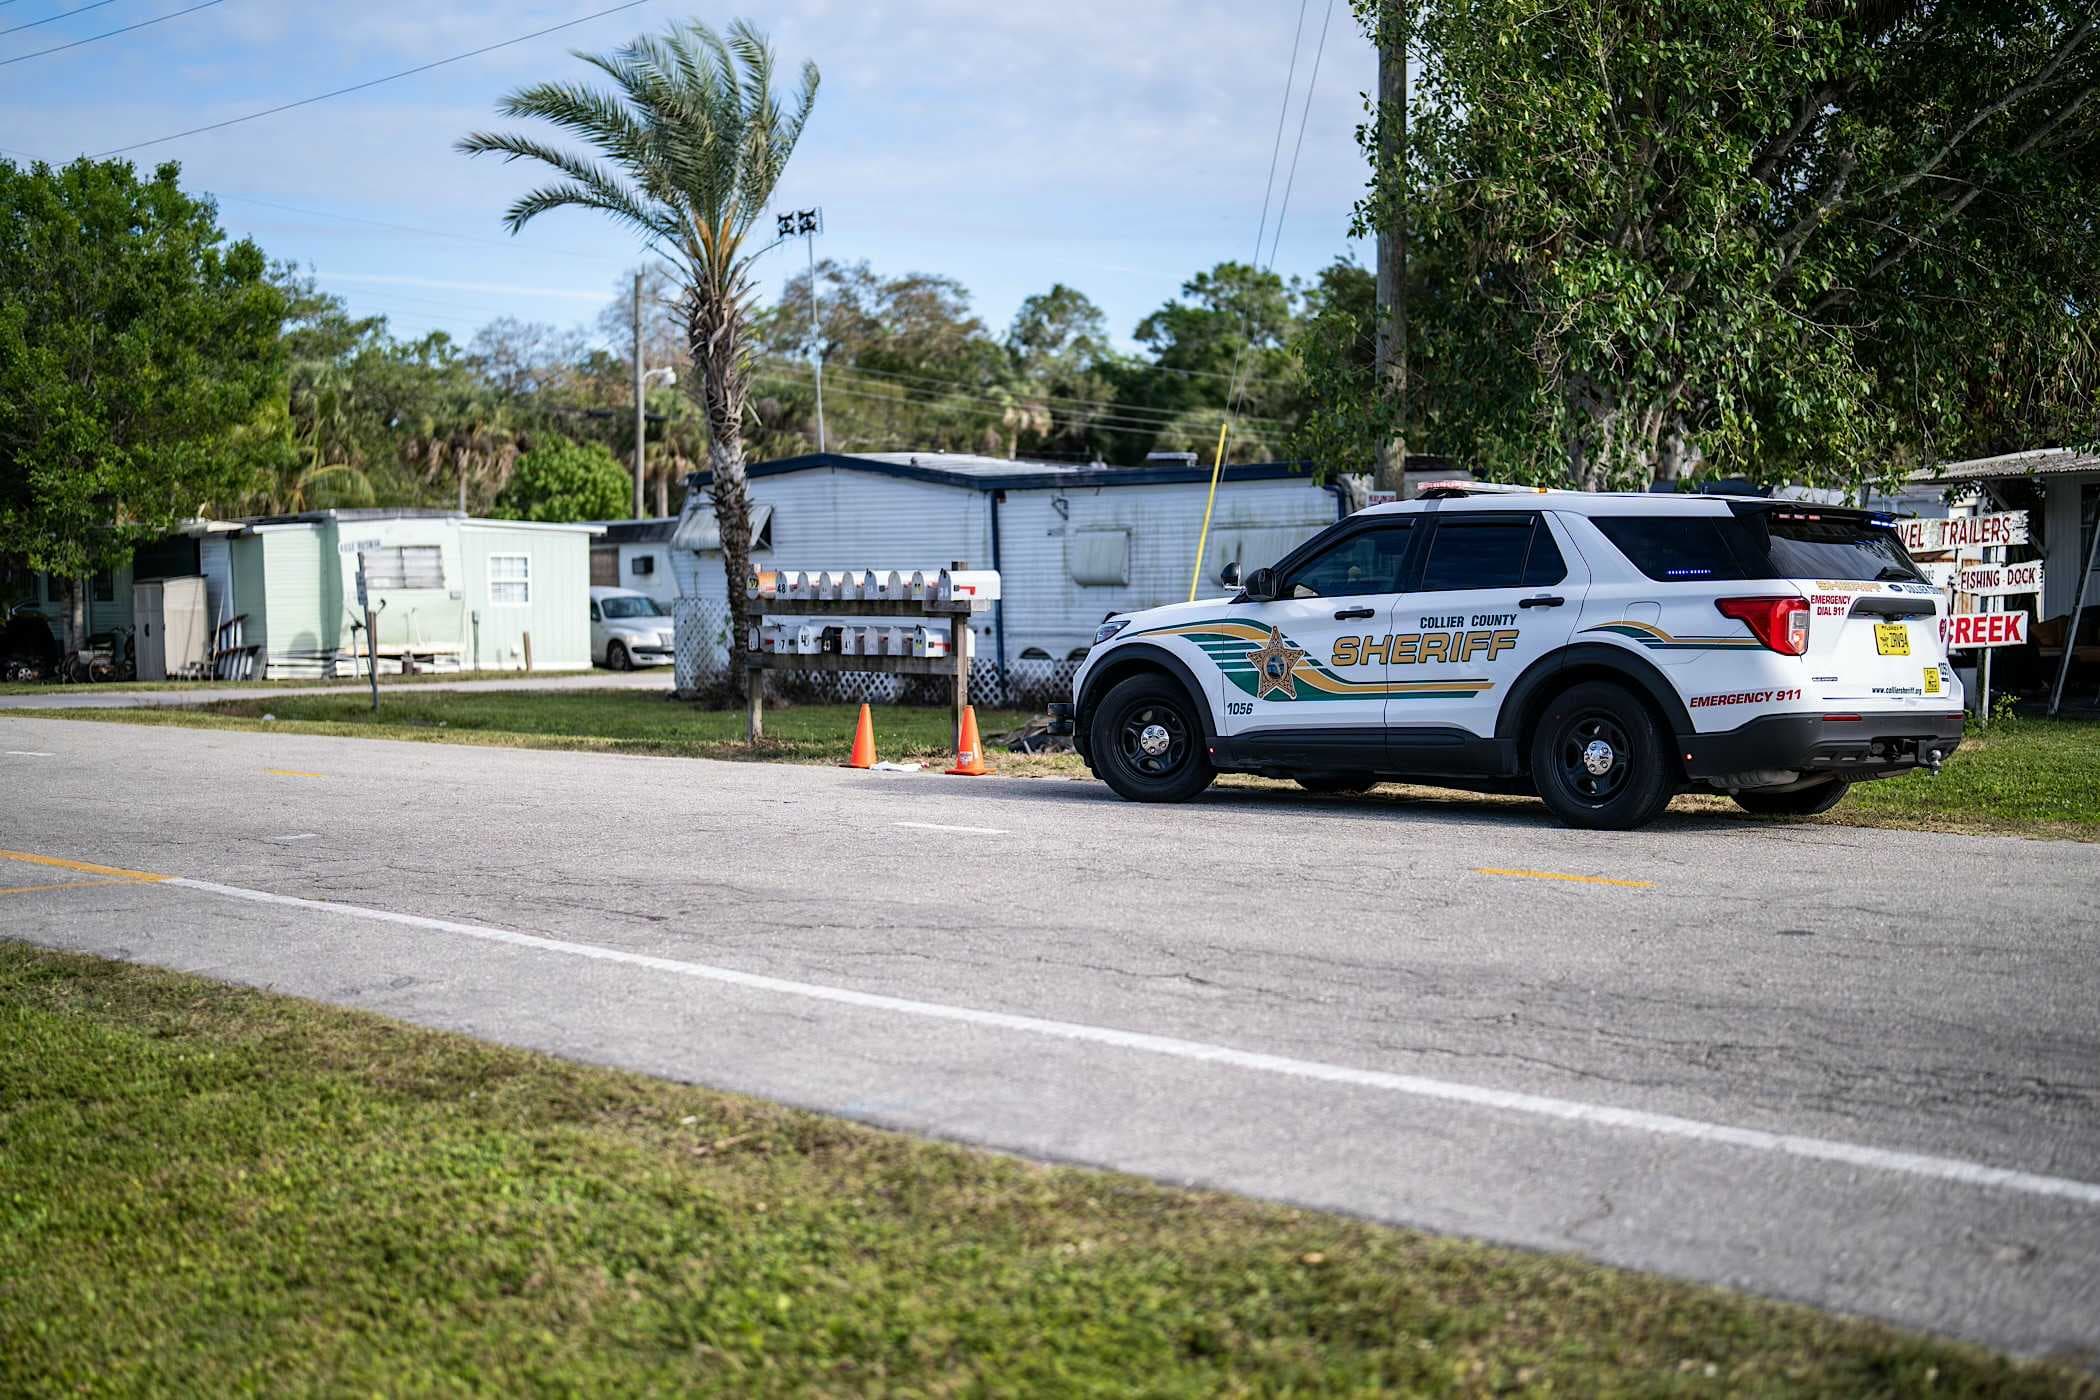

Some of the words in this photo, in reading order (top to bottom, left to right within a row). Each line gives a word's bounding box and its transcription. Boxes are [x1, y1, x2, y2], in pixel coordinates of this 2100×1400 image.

[1940, 517, 2010, 545] TRAILERS
[1961, 569, 2000, 590] FISHING
[2007, 567, 2036, 585] DOCK
[777, 584, 786, 594] 48
[1811, 595, 1851, 605] EMERGENCY
[1817, 606, 1833, 616] DIAL
[1833, 606, 1845, 616] 911
[1420, 616, 1465, 629] COLLIER
[1471, 613, 1517, 627] COUNTY
[1331, 629, 1520, 667] SHERIFF
[1690, 691, 1773, 708] EMERGENCY
[1776, 688, 1802, 701] 911
[1227, 702, 1254, 715] 1056
